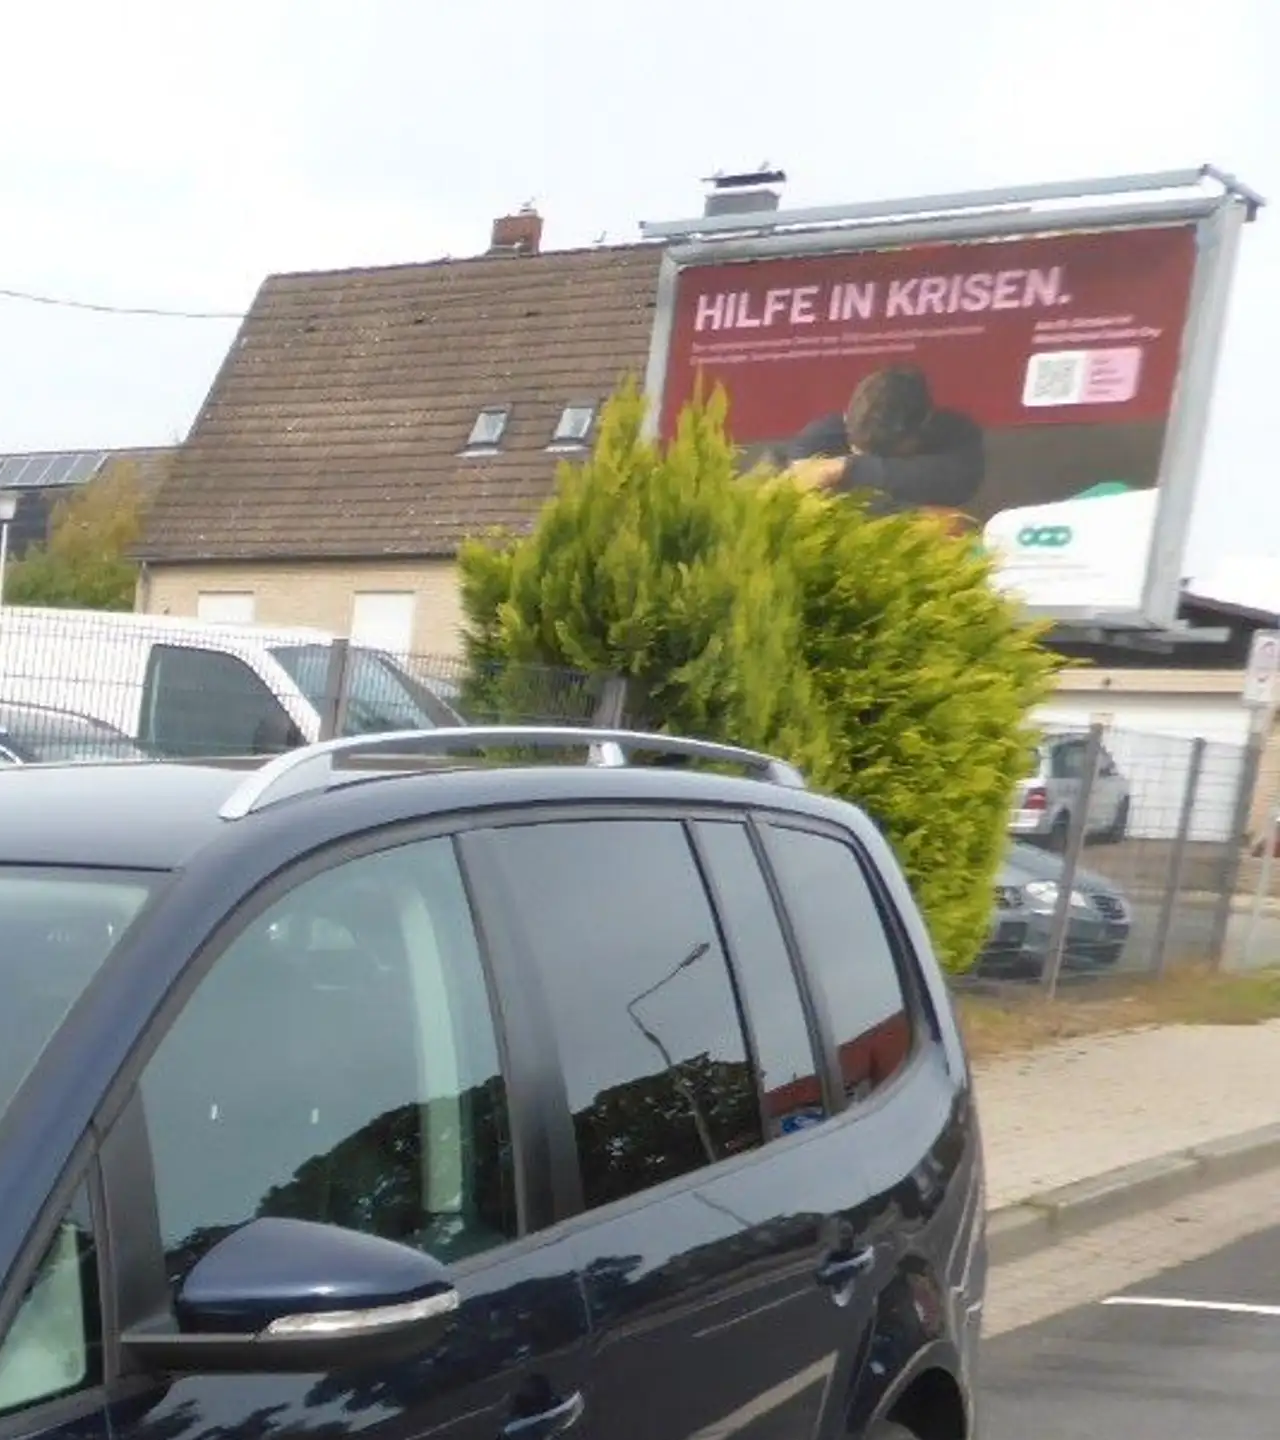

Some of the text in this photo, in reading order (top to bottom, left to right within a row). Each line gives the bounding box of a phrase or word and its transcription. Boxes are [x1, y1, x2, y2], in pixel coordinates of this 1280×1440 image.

[694, 266, 1072, 331] HILFE IN KRISEN.
